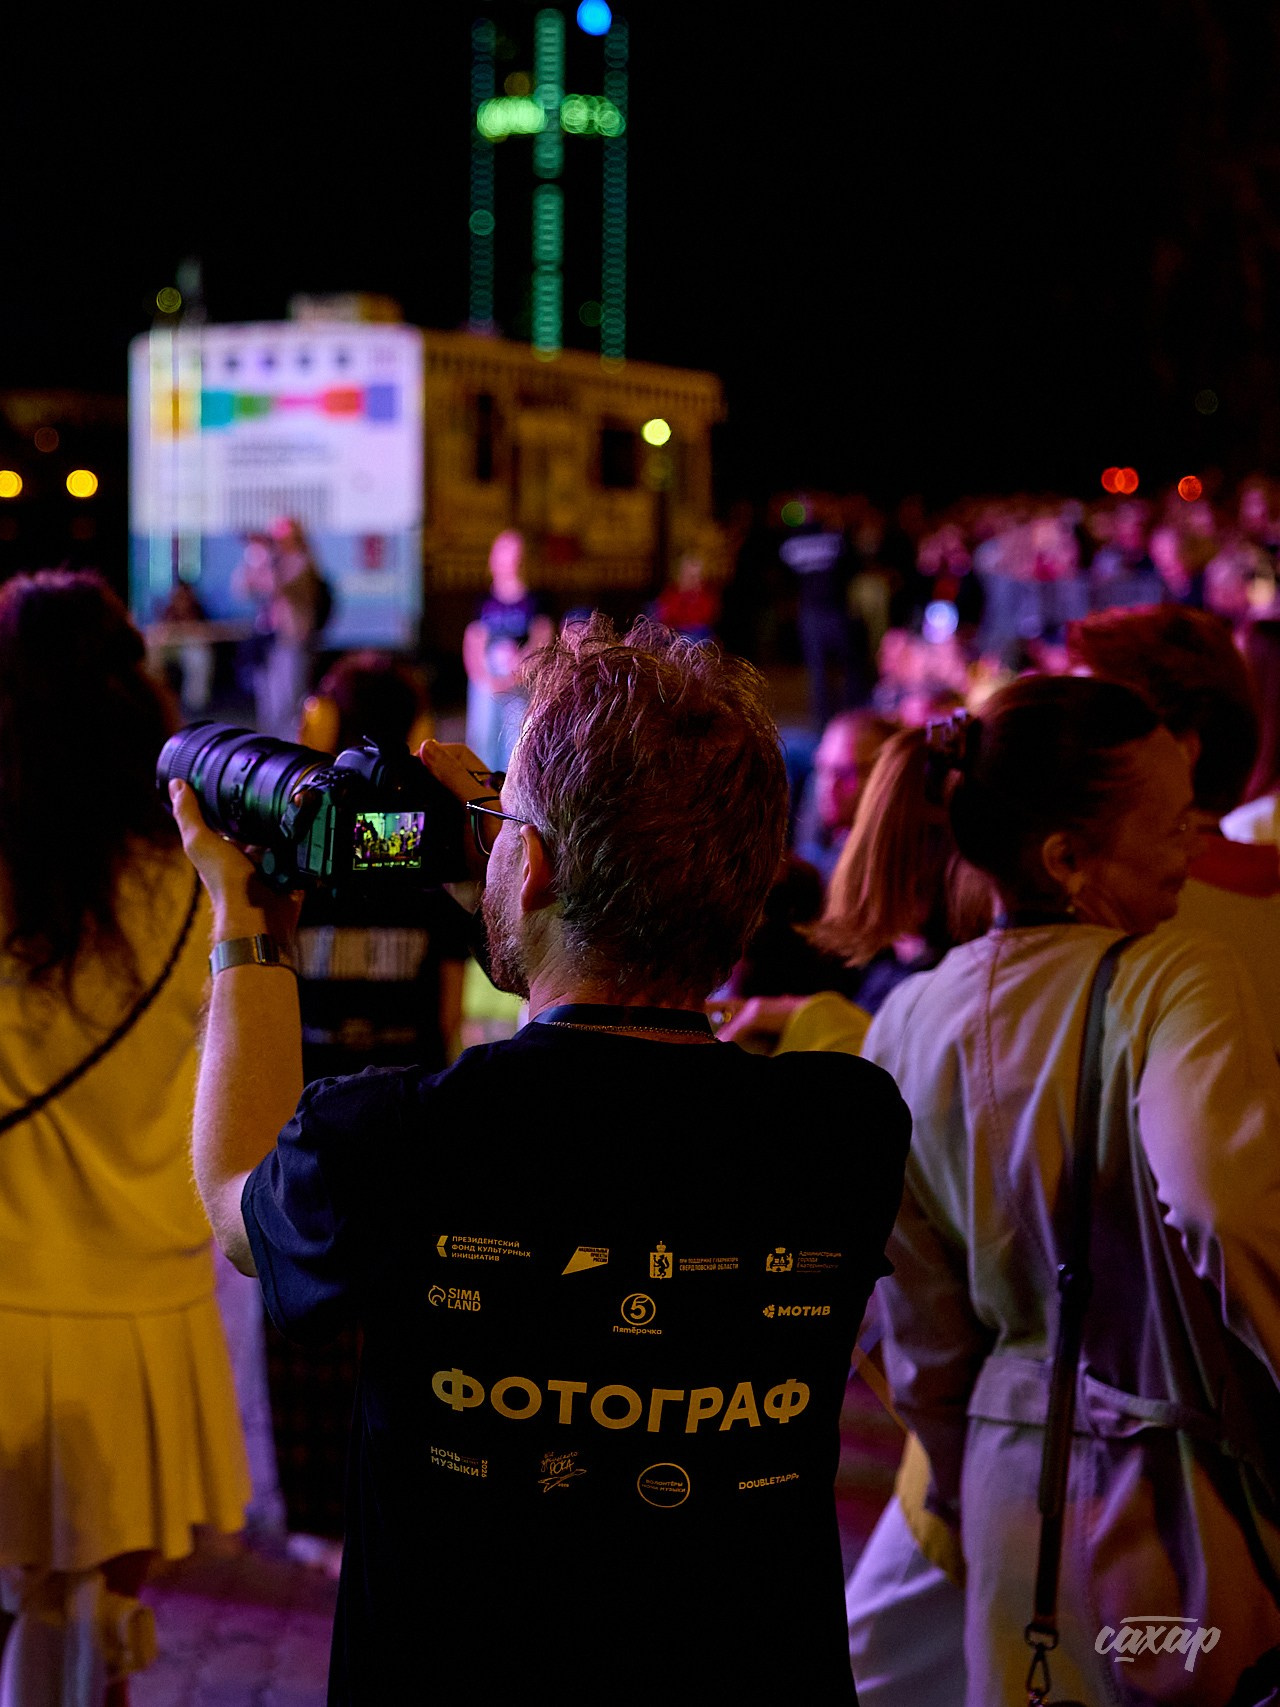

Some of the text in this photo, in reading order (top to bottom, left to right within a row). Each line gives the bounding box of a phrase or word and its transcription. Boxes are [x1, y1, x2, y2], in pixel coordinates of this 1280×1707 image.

[452, 1236, 520, 1248] ПРЕЗИДЕНТСКИЙ
[451, 1244, 531, 1258] ФОНД КУЛЬТУРНЫХ
[451, 1252, 500, 1262] ИНИЦИАТИВ
[448, 1288, 480, 1301] SIMA
[448, 1299, 481, 1311] LAND
[631, 1296, 649, 1319] 5
[778, 1306, 831, 1317] МОТИВ
[613, 1326, 663, 1335] Пятёрочка
[431, 1368, 810, 1433] ФОТОГРАФ
[431, 1446, 460, 1462] НОЧЬ
[431, 1456, 479, 1477] МУЗЫКИ
